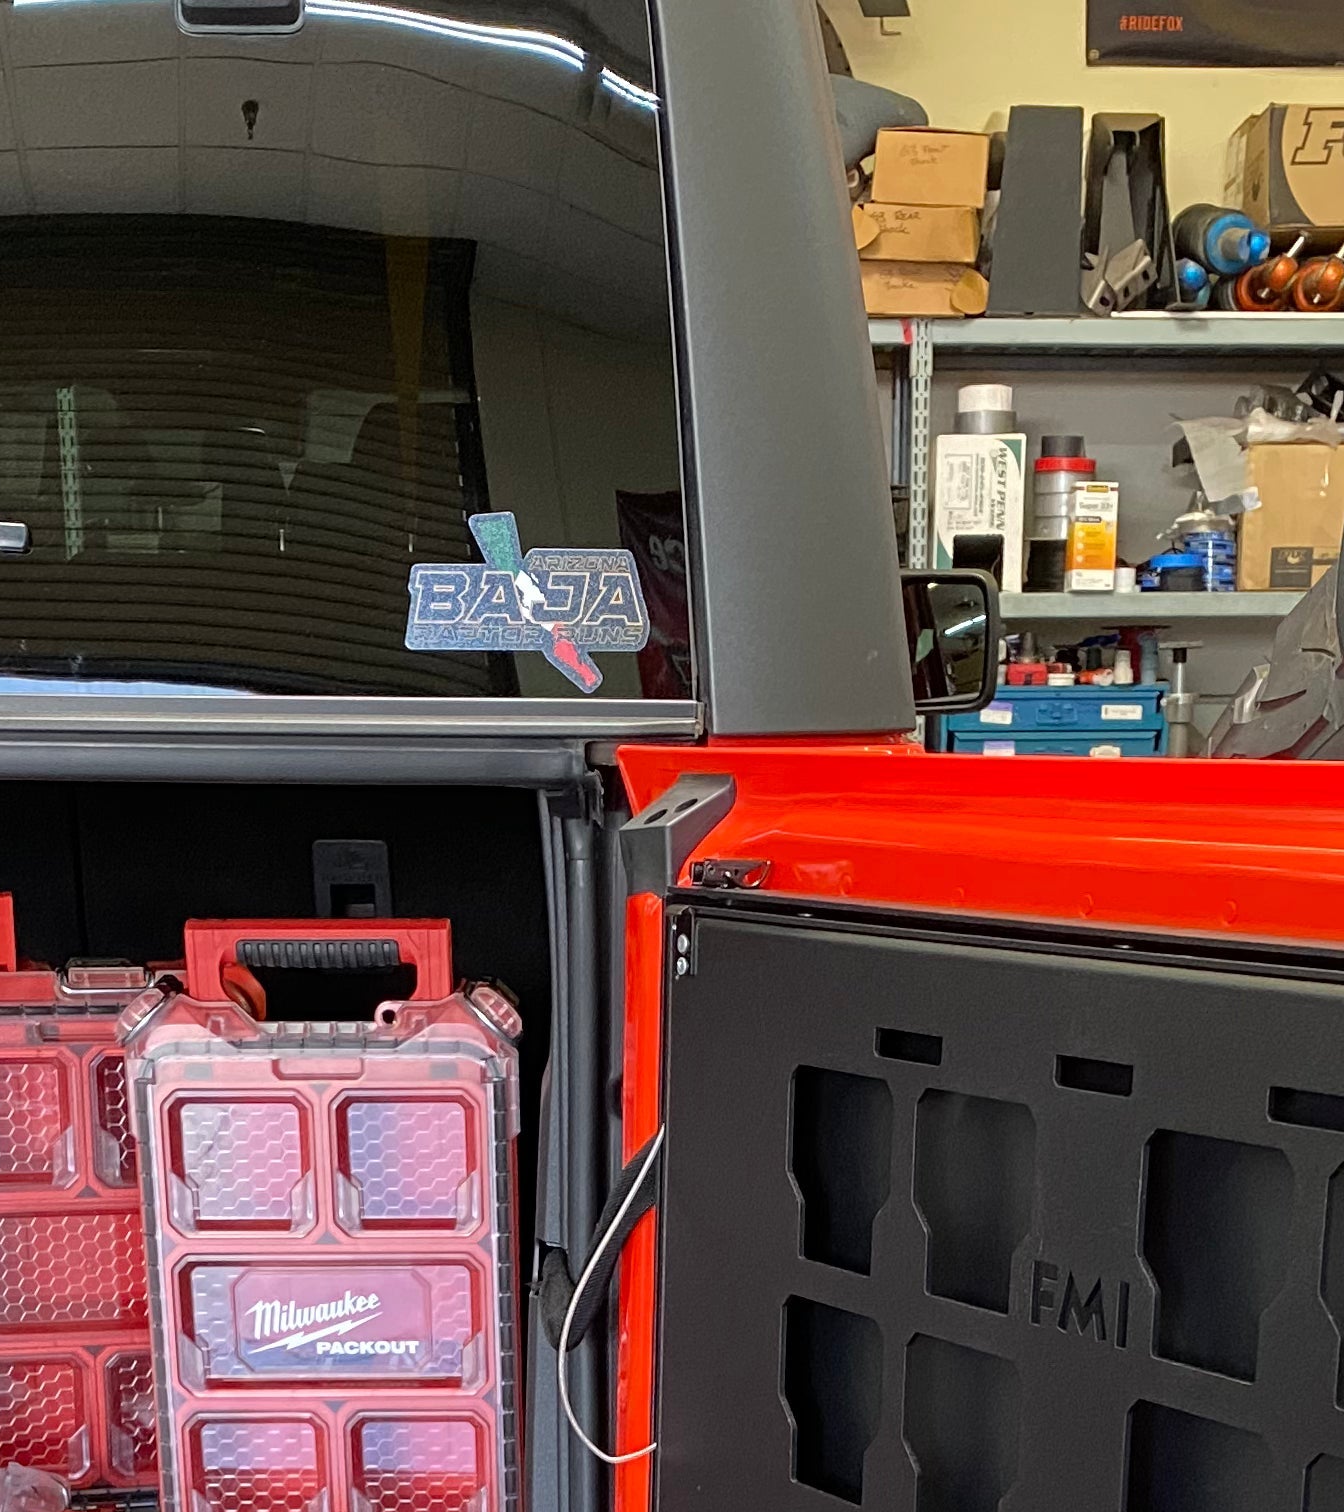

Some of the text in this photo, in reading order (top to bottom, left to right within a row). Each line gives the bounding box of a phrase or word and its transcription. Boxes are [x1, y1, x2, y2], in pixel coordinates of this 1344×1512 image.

[1119, 15, 1183, 31] #RIDEFOX
[996, 448, 1007, 531] WEST PENN
[528, 556, 629, 571] ARIZONA
[414, 571, 644, 625] BAJA
[412, 625, 644, 645] RAPTOR RUNS
[244, 1290, 382, 1340] Milwaukee
[1029, 1260, 1131, 1350] FMI
[316, 1340, 420, 1355] PACKOUT
